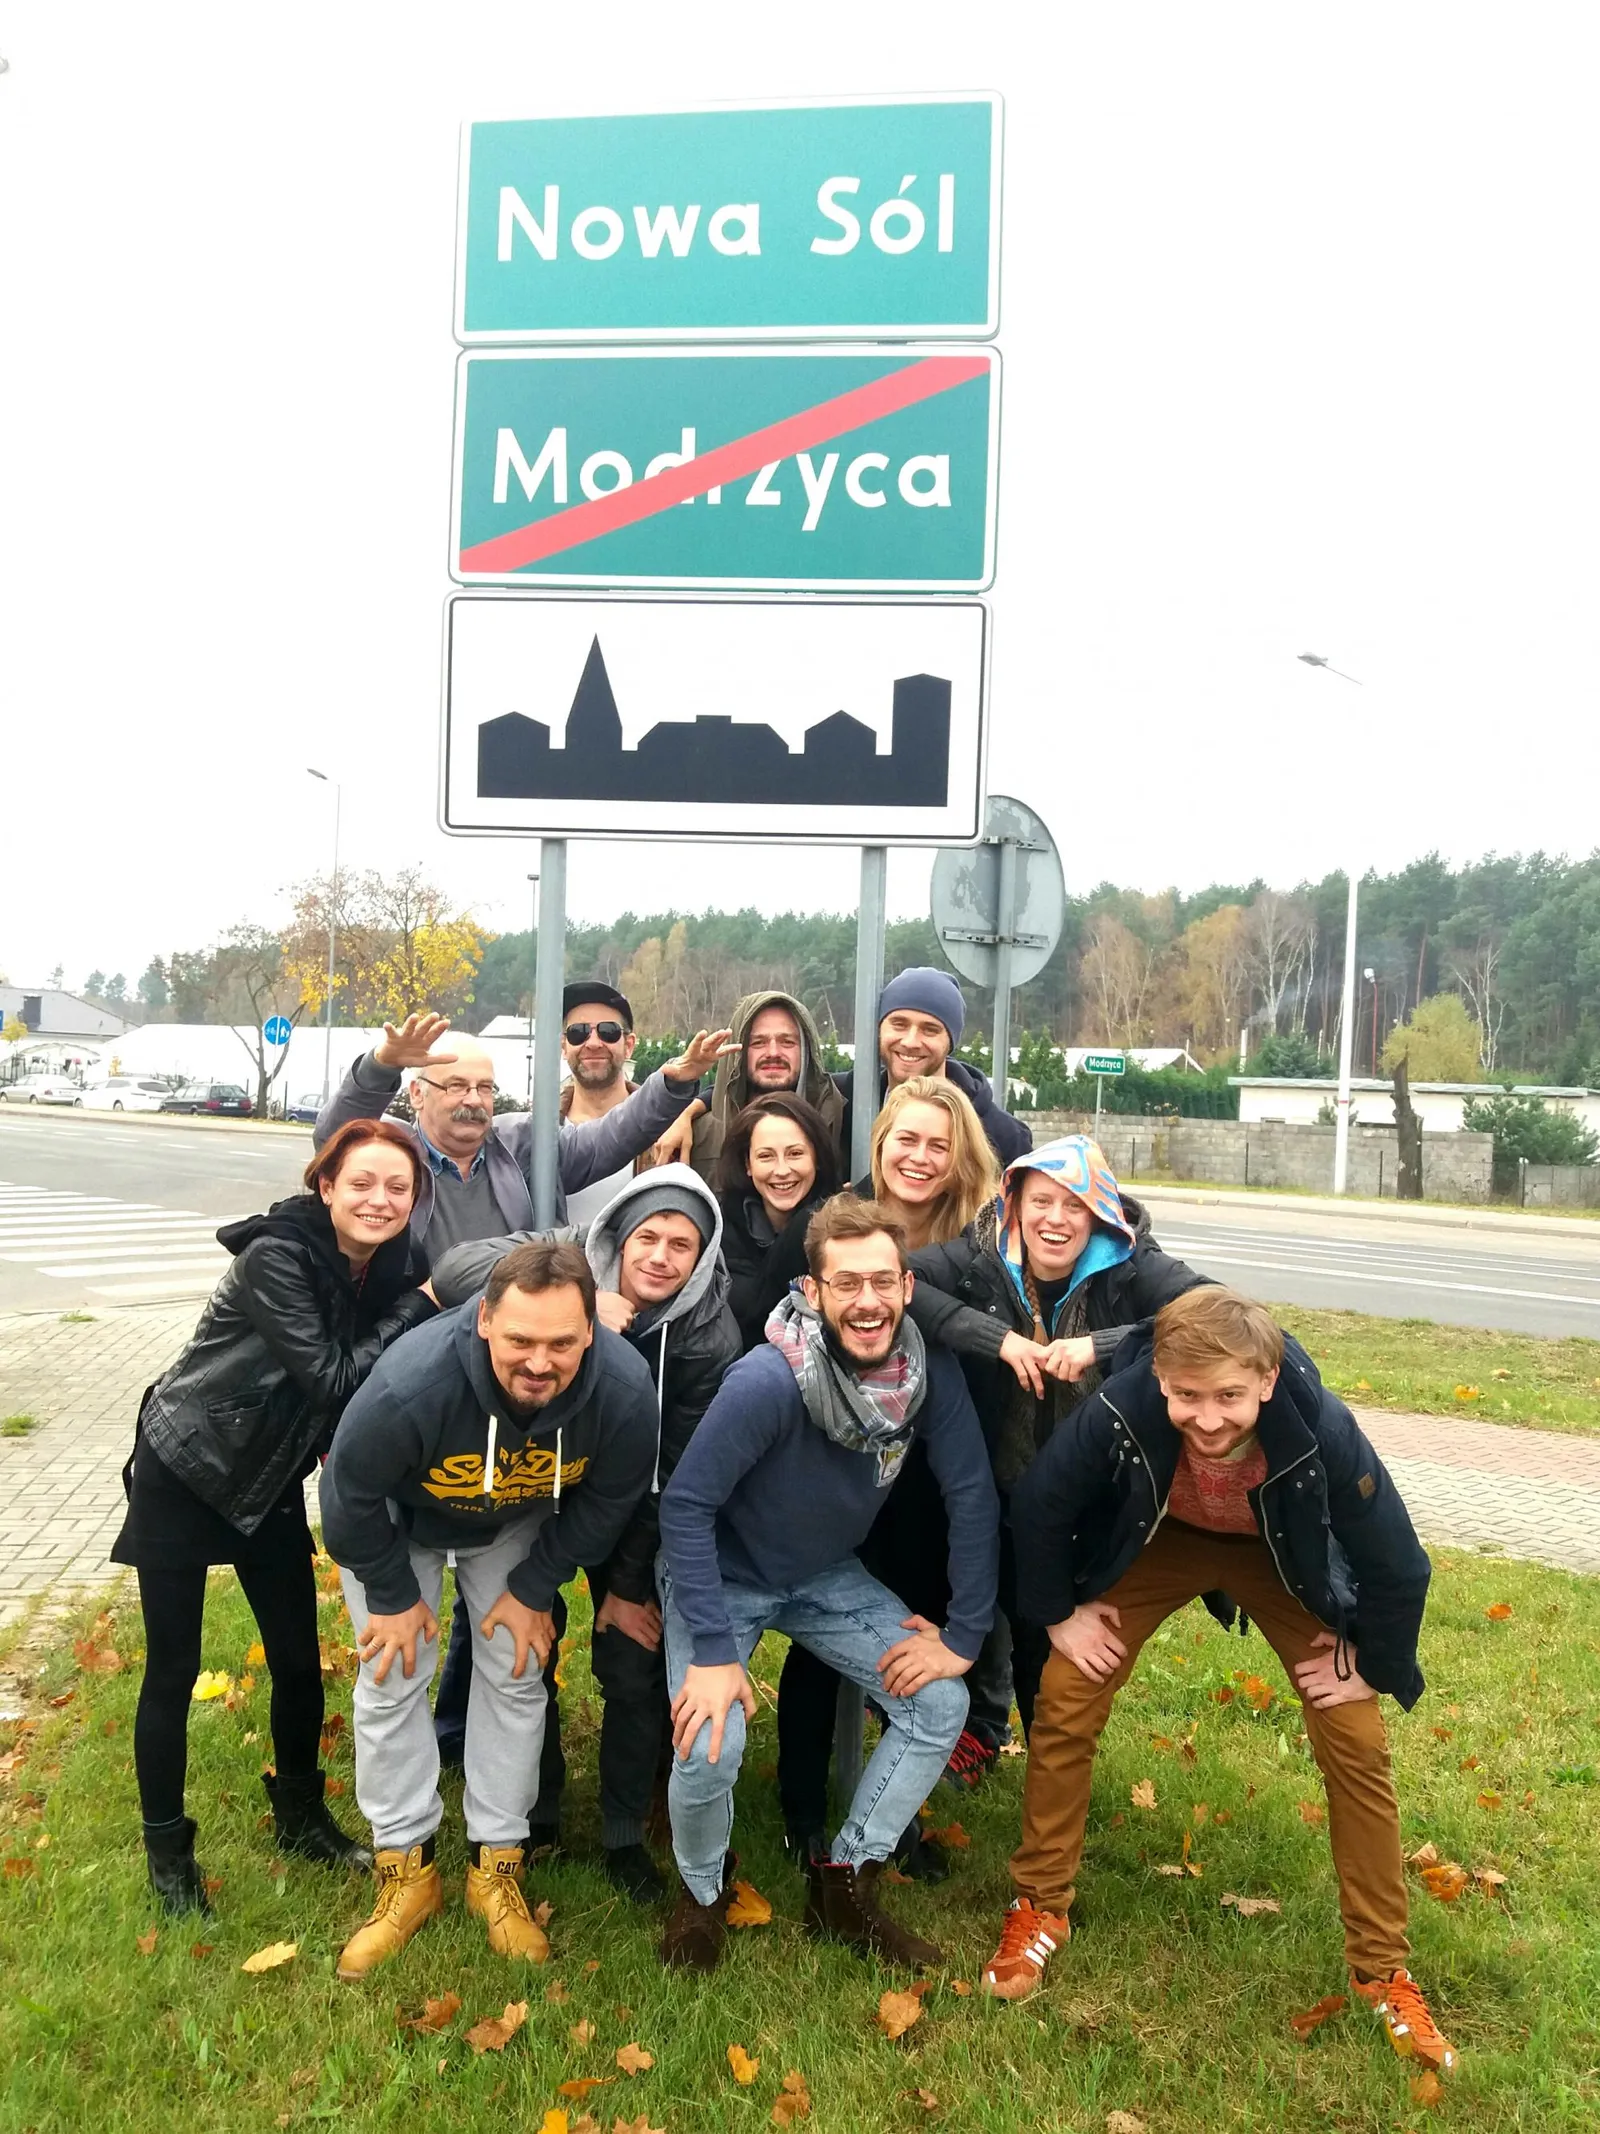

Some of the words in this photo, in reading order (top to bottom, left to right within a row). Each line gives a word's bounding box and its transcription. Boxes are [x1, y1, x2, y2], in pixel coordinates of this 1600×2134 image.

[497, 184, 761, 262] Nowa
[809, 173, 955, 256] Sól
[493, 427, 952, 531] Modzyca
[1089, 1057, 1121, 1071] Modrzyca
[381, 1864, 398, 1878] CAT
[496, 1860, 518, 1875] CAT
